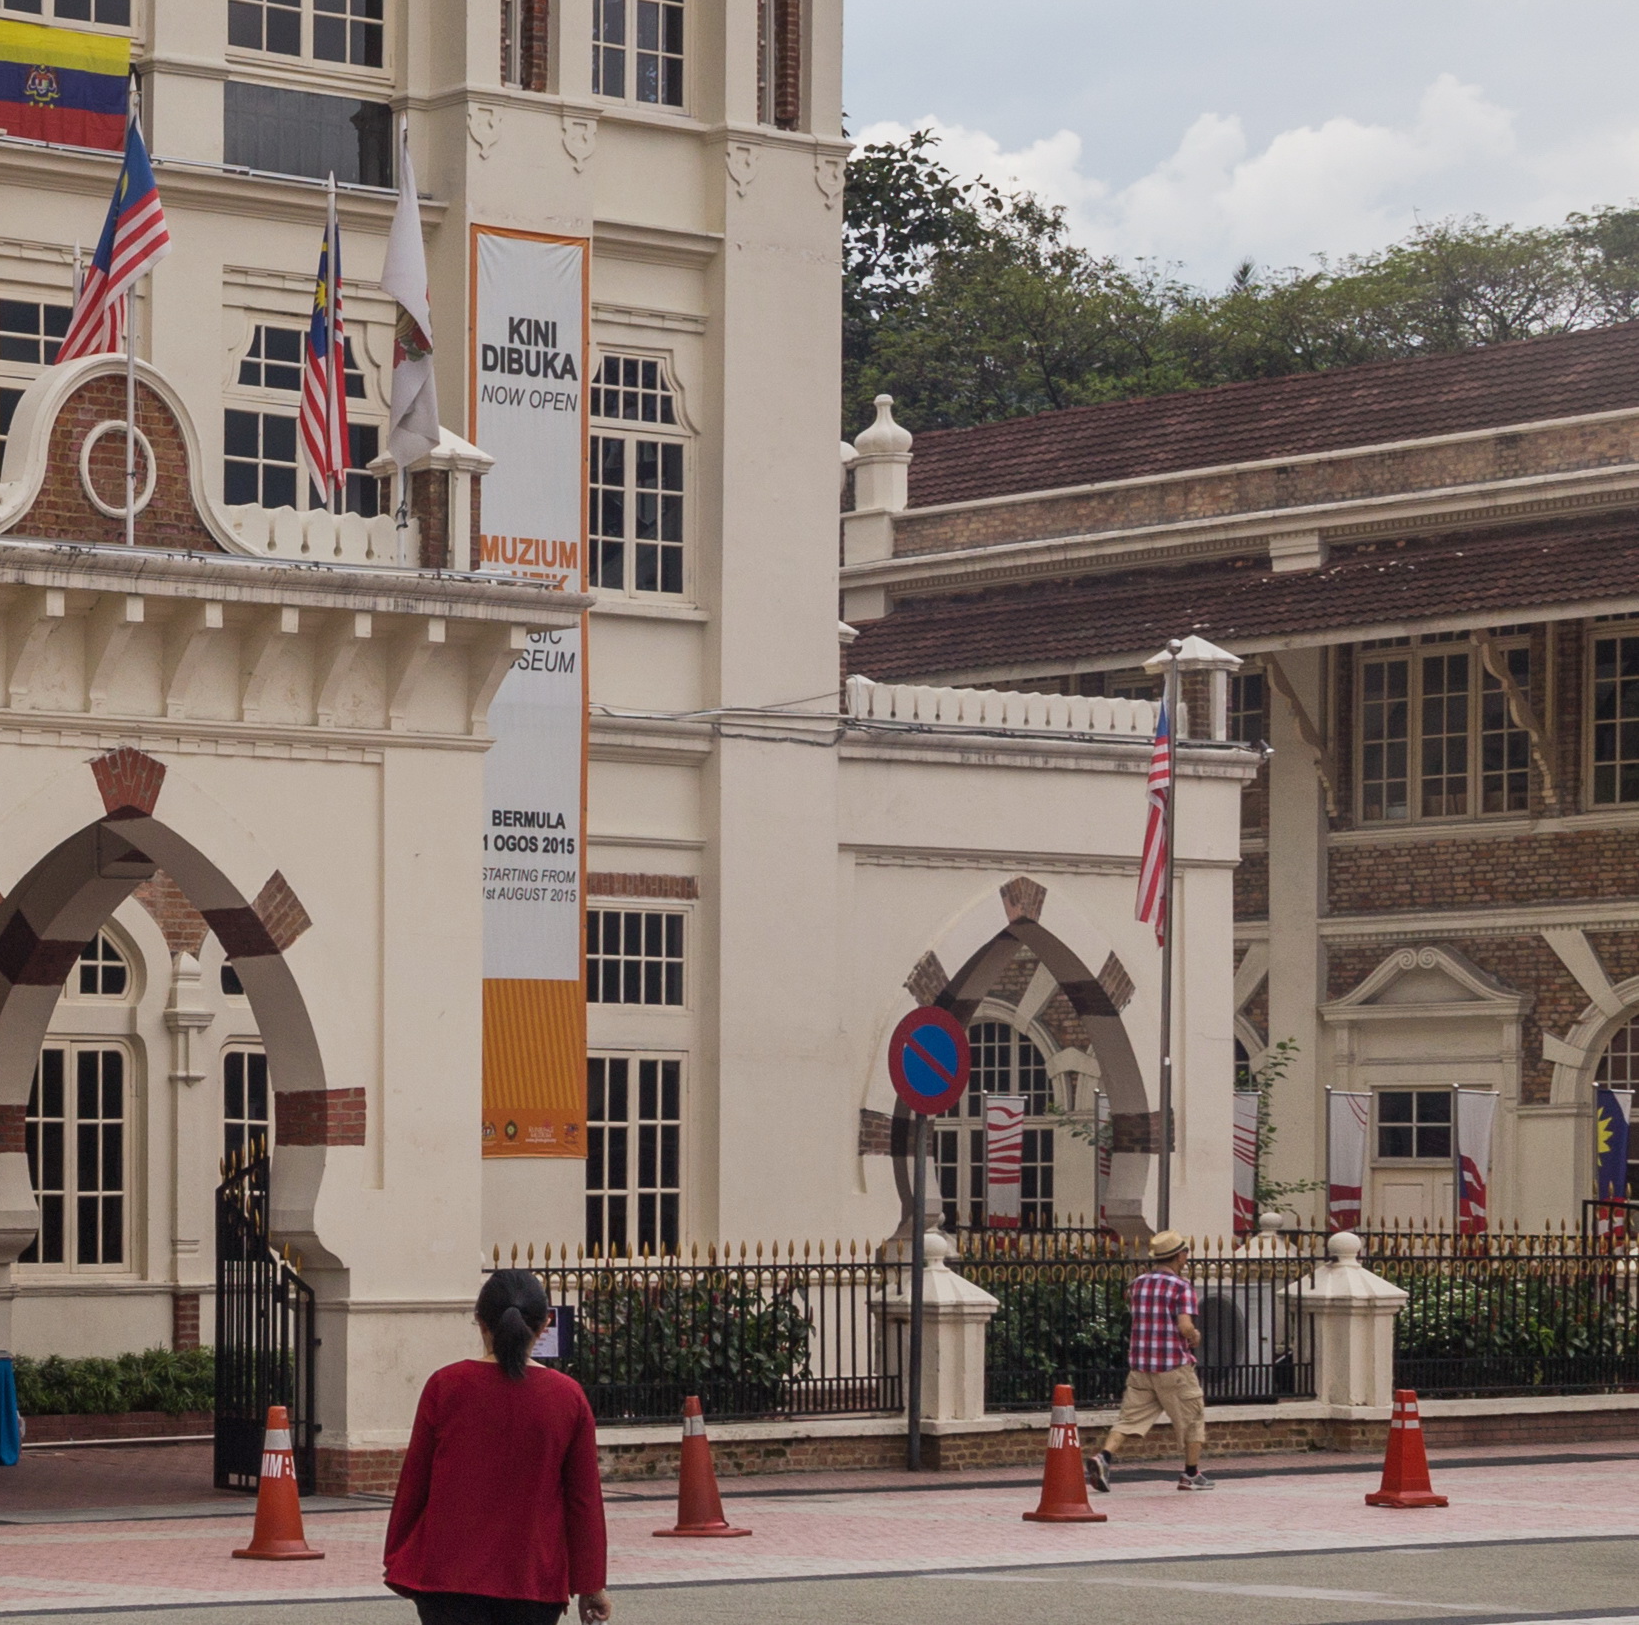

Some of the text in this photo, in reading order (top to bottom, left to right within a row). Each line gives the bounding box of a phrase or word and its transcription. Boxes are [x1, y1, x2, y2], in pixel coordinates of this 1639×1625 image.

[508, 316, 557, 349] KINI
[482, 343, 578, 381] DIBUKA
[481, 384, 578, 412] NOW OPEN
[480, 534, 578, 569] MUZIUM
[491, 809, 566, 829] BERMULA
[482, 834, 575, 854] 1 OGOS 2015
[541, 869, 576, 884] FROM
[497, 887, 548, 902] AUGUST
[550, 888, 577, 903] 2015
